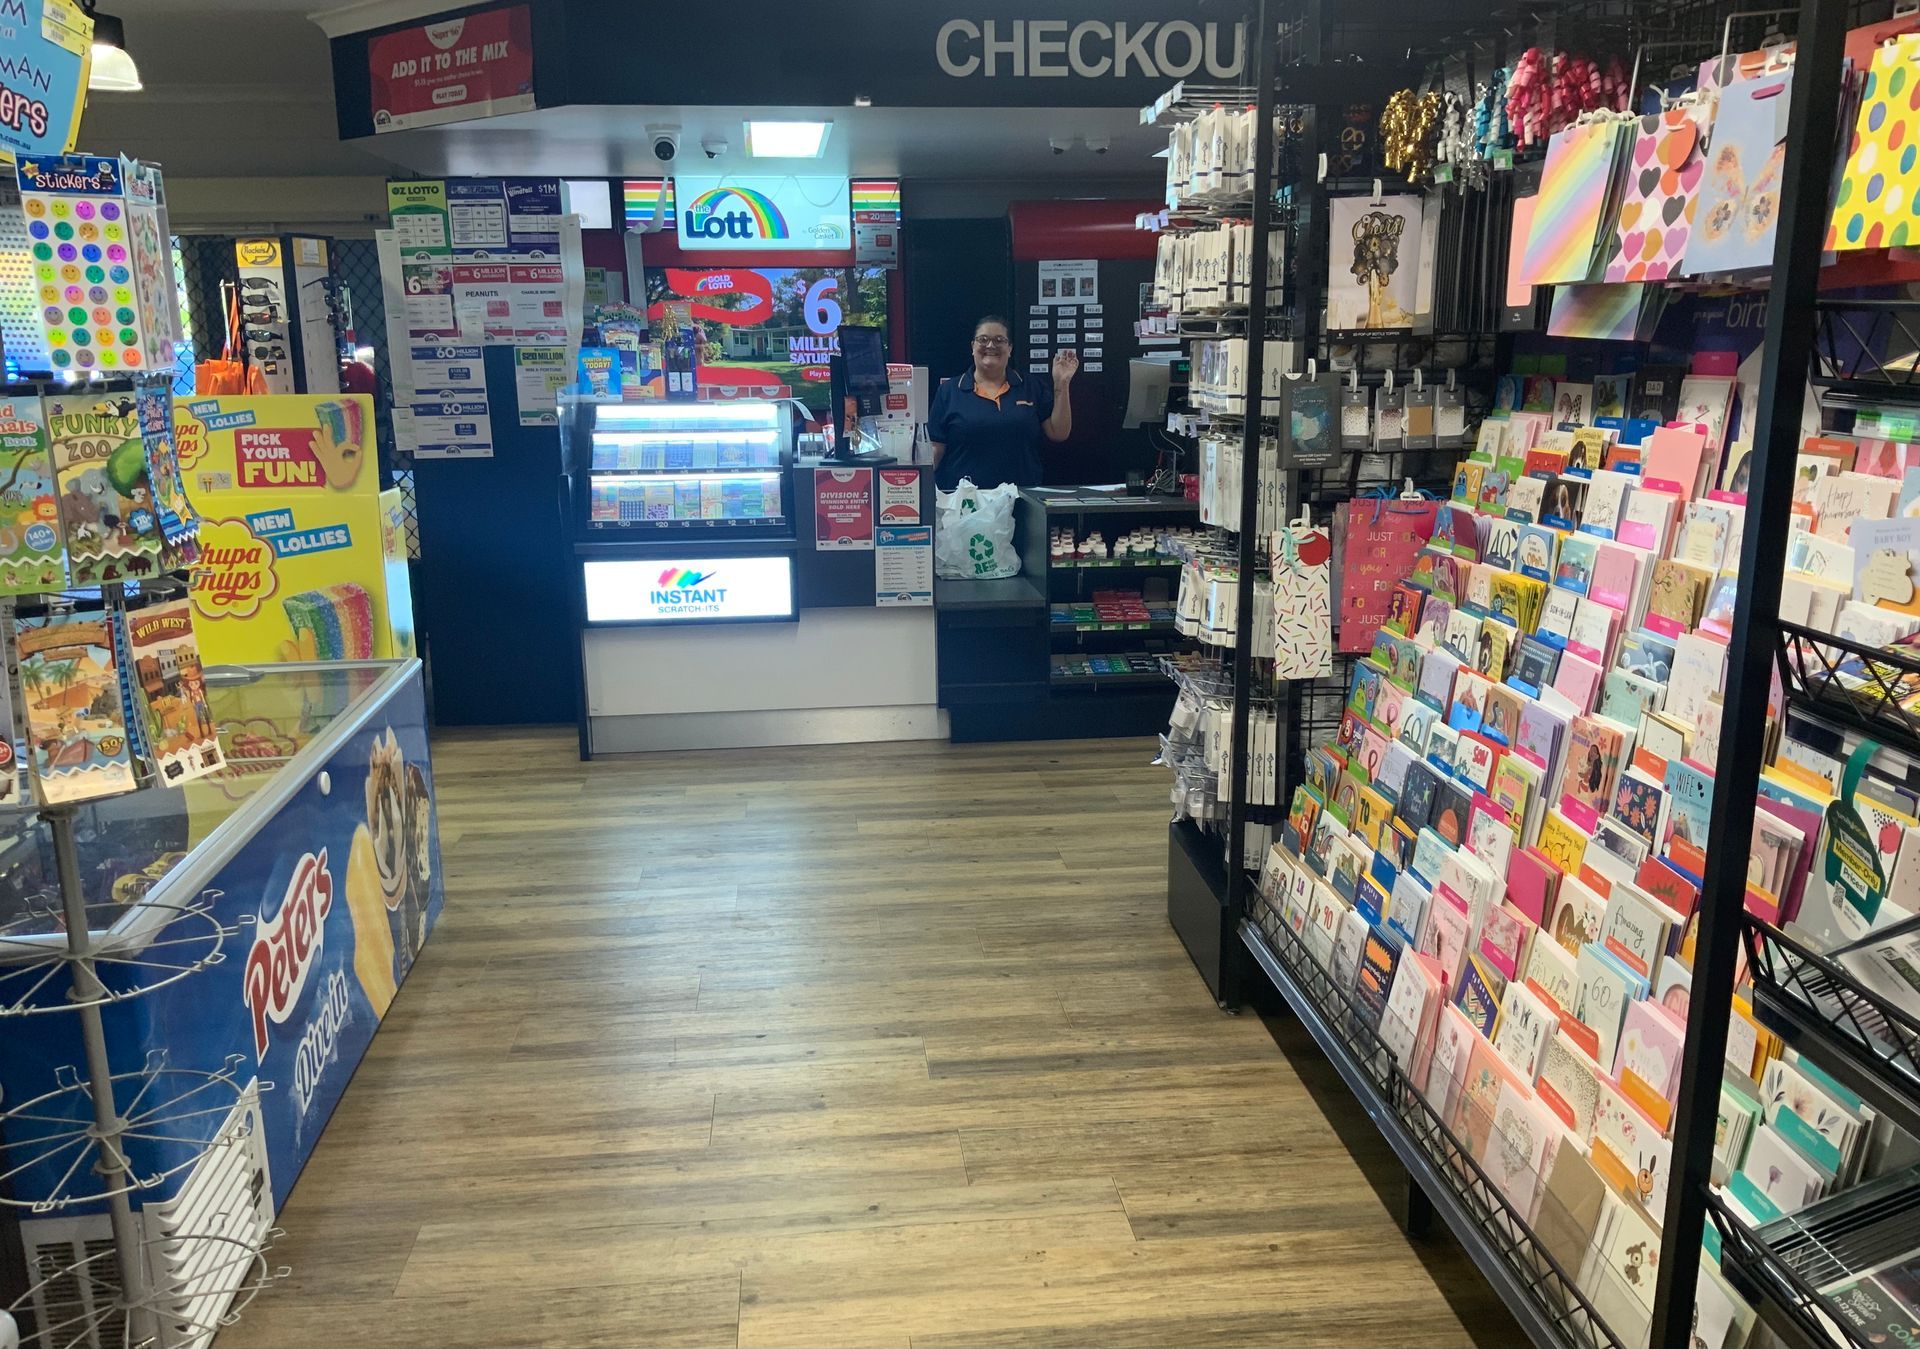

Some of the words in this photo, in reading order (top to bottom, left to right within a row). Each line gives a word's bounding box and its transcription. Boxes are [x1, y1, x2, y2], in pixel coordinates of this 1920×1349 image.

[936, 19, 1244, 79] CHECKOU
[392, 60, 416, 79] ADD
[421, 57, 431, 73] IT
[435, 54, 450, 69] TO
[455, 47, 477, 66] THE
[483, 41, 508, 62] MIX
[449, 89, 464, 99] TODAY
[35, 171, 101, 190] stickers
[538, 183, 557, 195] $1M
[391, 186, 405, 195] OZ
[408, 186, 439, 195] LOTTO
[695, 204, 710, 213] the
[685, 211, 753, 239] Lott
[707, 275, 731, 283] GOLD
[708, 281, 734, 290] LOTTO
[465, 290, 499, 298] PEANUTS
[537, 352, 564, 361] MILLION
[193, 403, 217, 415] NEW
[50, 413, 139, 437] FUNKY
[208, 413, 254, 429] LOLLIES
[4, 436, 37, 447] Book
[241, 433, 282, 446] PICK
[66, 439, 113, 462] ZOO
[242, 447, 291, 460] YOUR
[244, 461, 317, 484] FUN!
[1825, 482, 1854, 507] Happy
[253, 513, 291, 533] NEW
[28, 529, 50, 540] 140+
[278, 529, 347, 553] LOLLIES
[1367, 532, 1394, 541] JUST
[650, 589, 727, 604] INSTANT
[658, 605, 720, 614] SCRATCH-ITS
[136, 619, 160, 639] WILD
[161, 617, 187, 629] WEST
[1360, 615, 1386, 624] JUST
[1473, 745, 1488, 767] SON
[1676, 771, 1695, 797] WIFE
[1360, 797, 1370, 825] 70
[1835, 841, 1879, 889] Member-Only
[1843, 866, 1866, 893] Prices!
[1616, 904, 1646, 948] Amazing
[245, 848, 332, 1065] Peters
[296, 1010, 333, 1114] Dive
[329, 969, 348, 1032] in
[1843, 1308, 1866, 1326] JUNE
